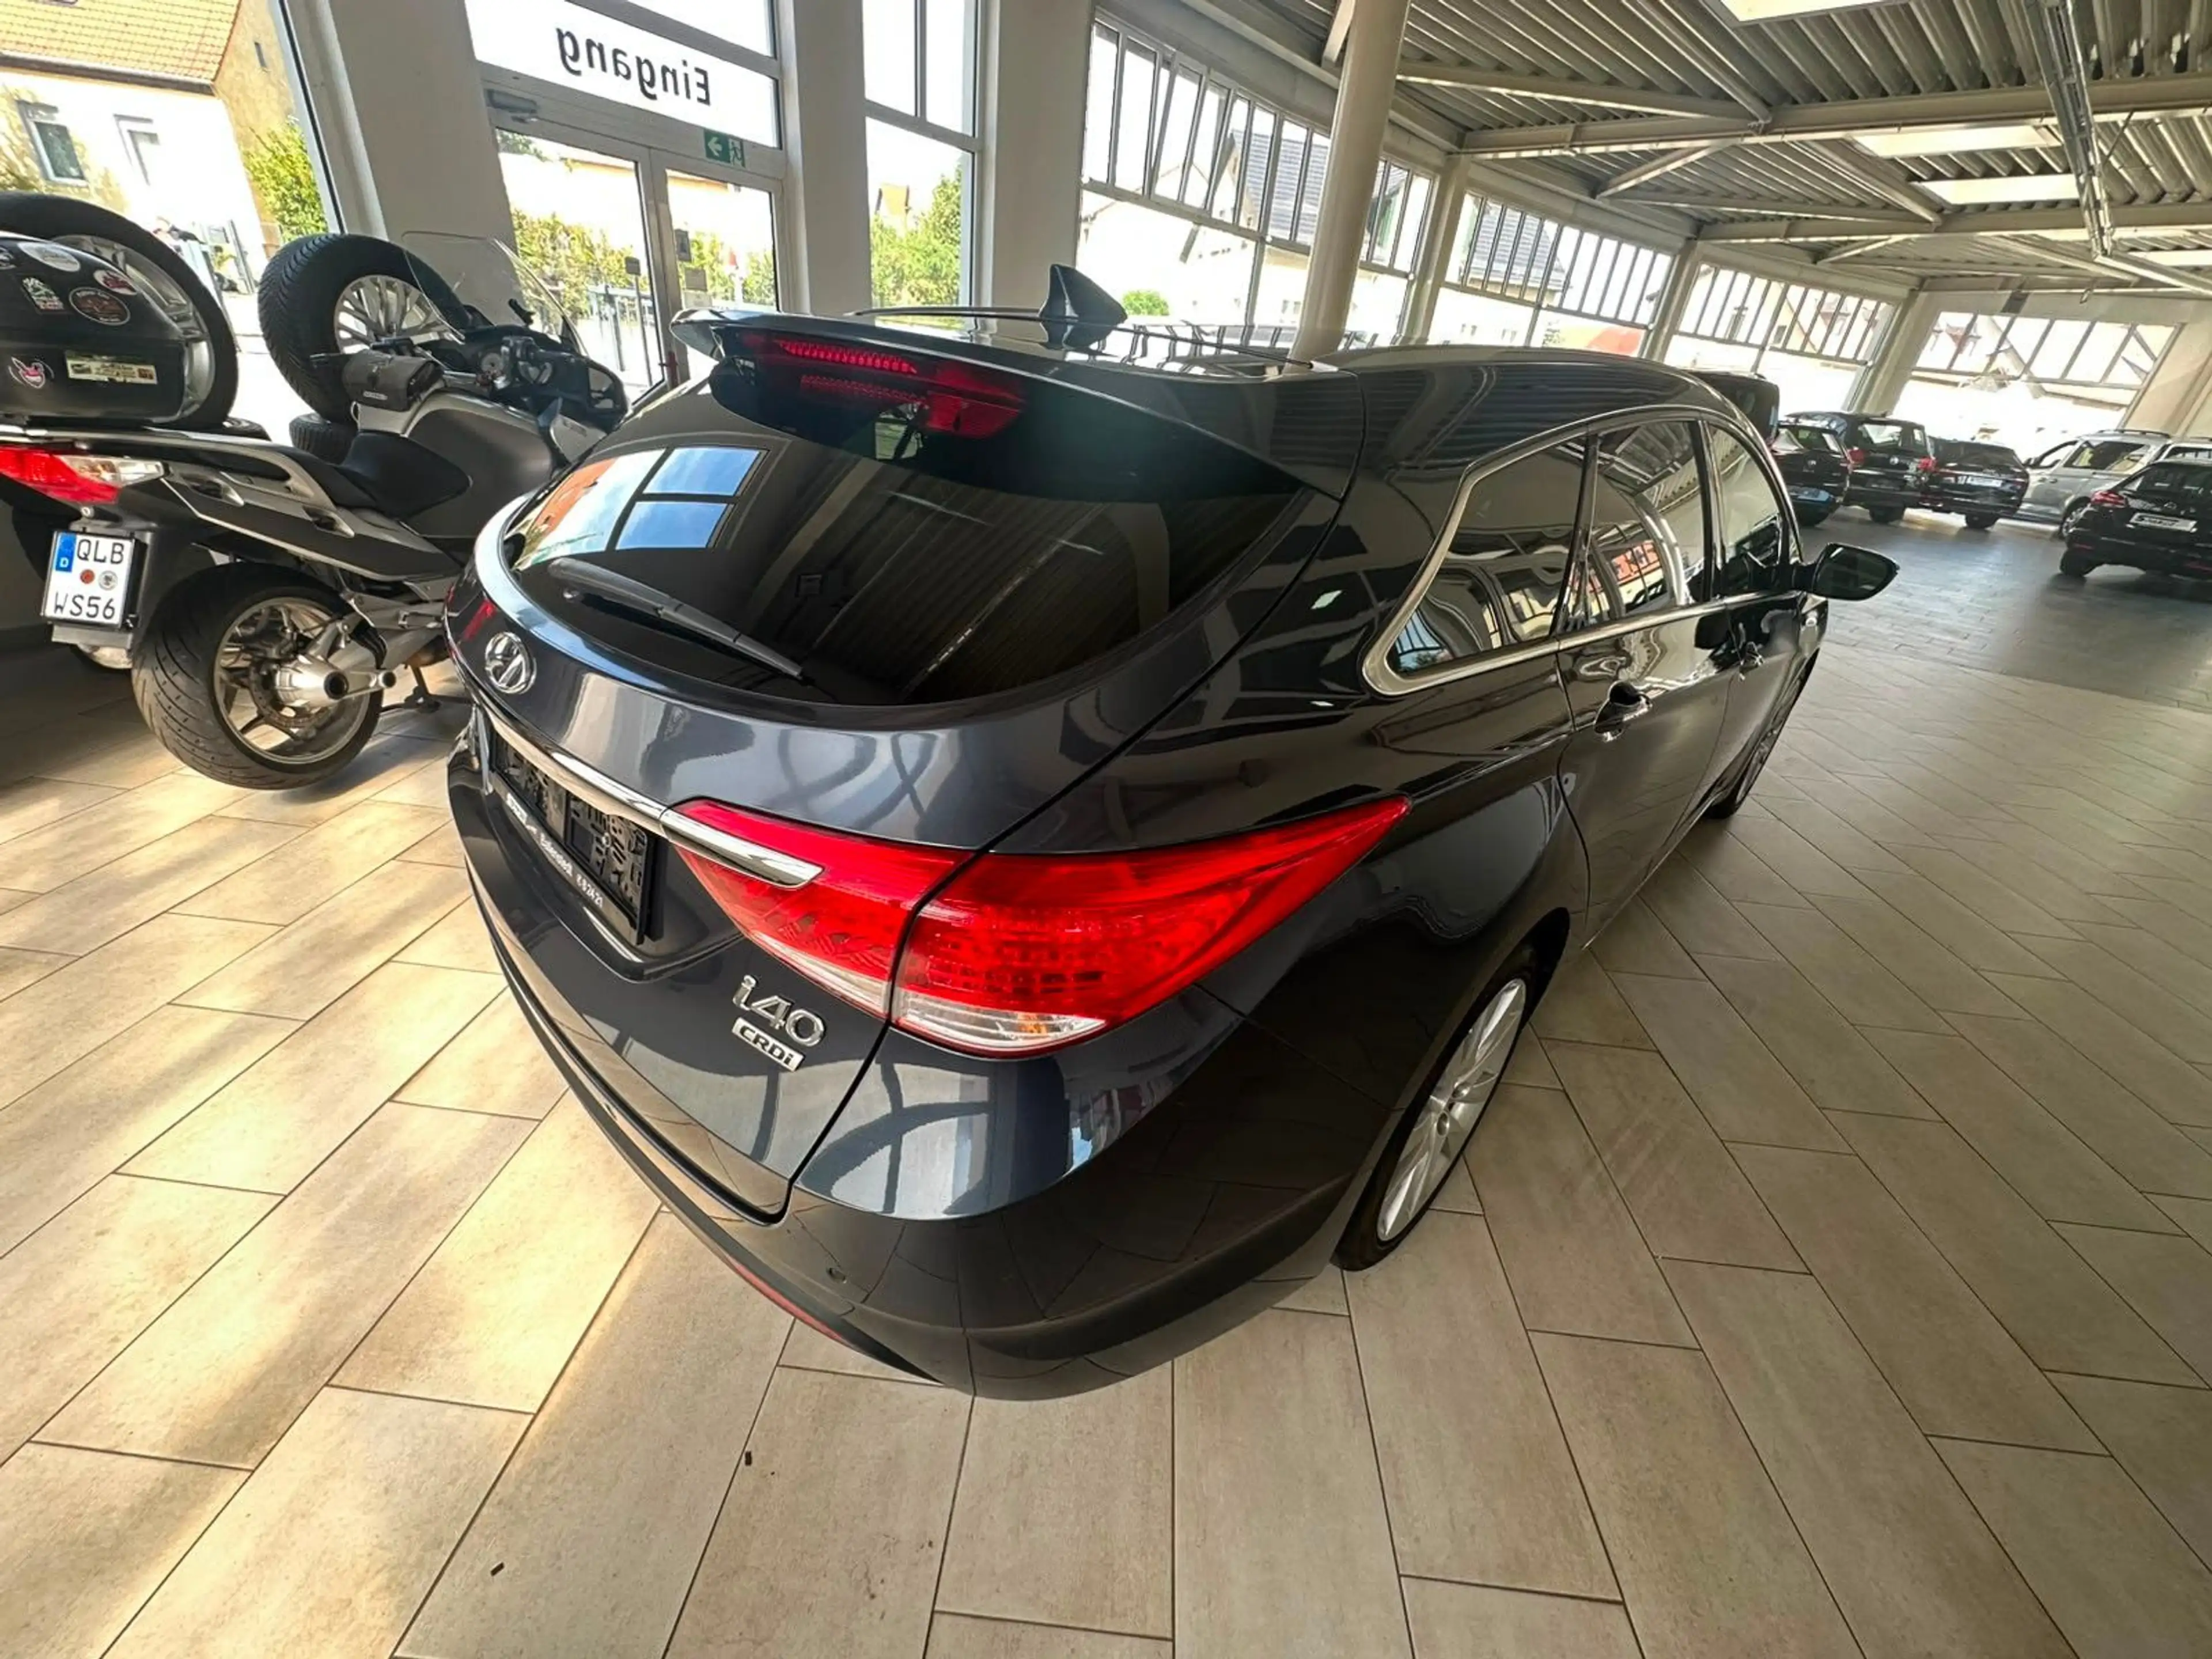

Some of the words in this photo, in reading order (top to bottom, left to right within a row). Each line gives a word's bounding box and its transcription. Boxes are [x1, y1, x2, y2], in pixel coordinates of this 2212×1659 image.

[59, 557, 69, 568] D
[77, 539, 124, 565] QLB
[54, 592, 115, 619] WS56
[732, 975, 825, 1047] i40
[739, 1025, 794, 1065] CRDi
